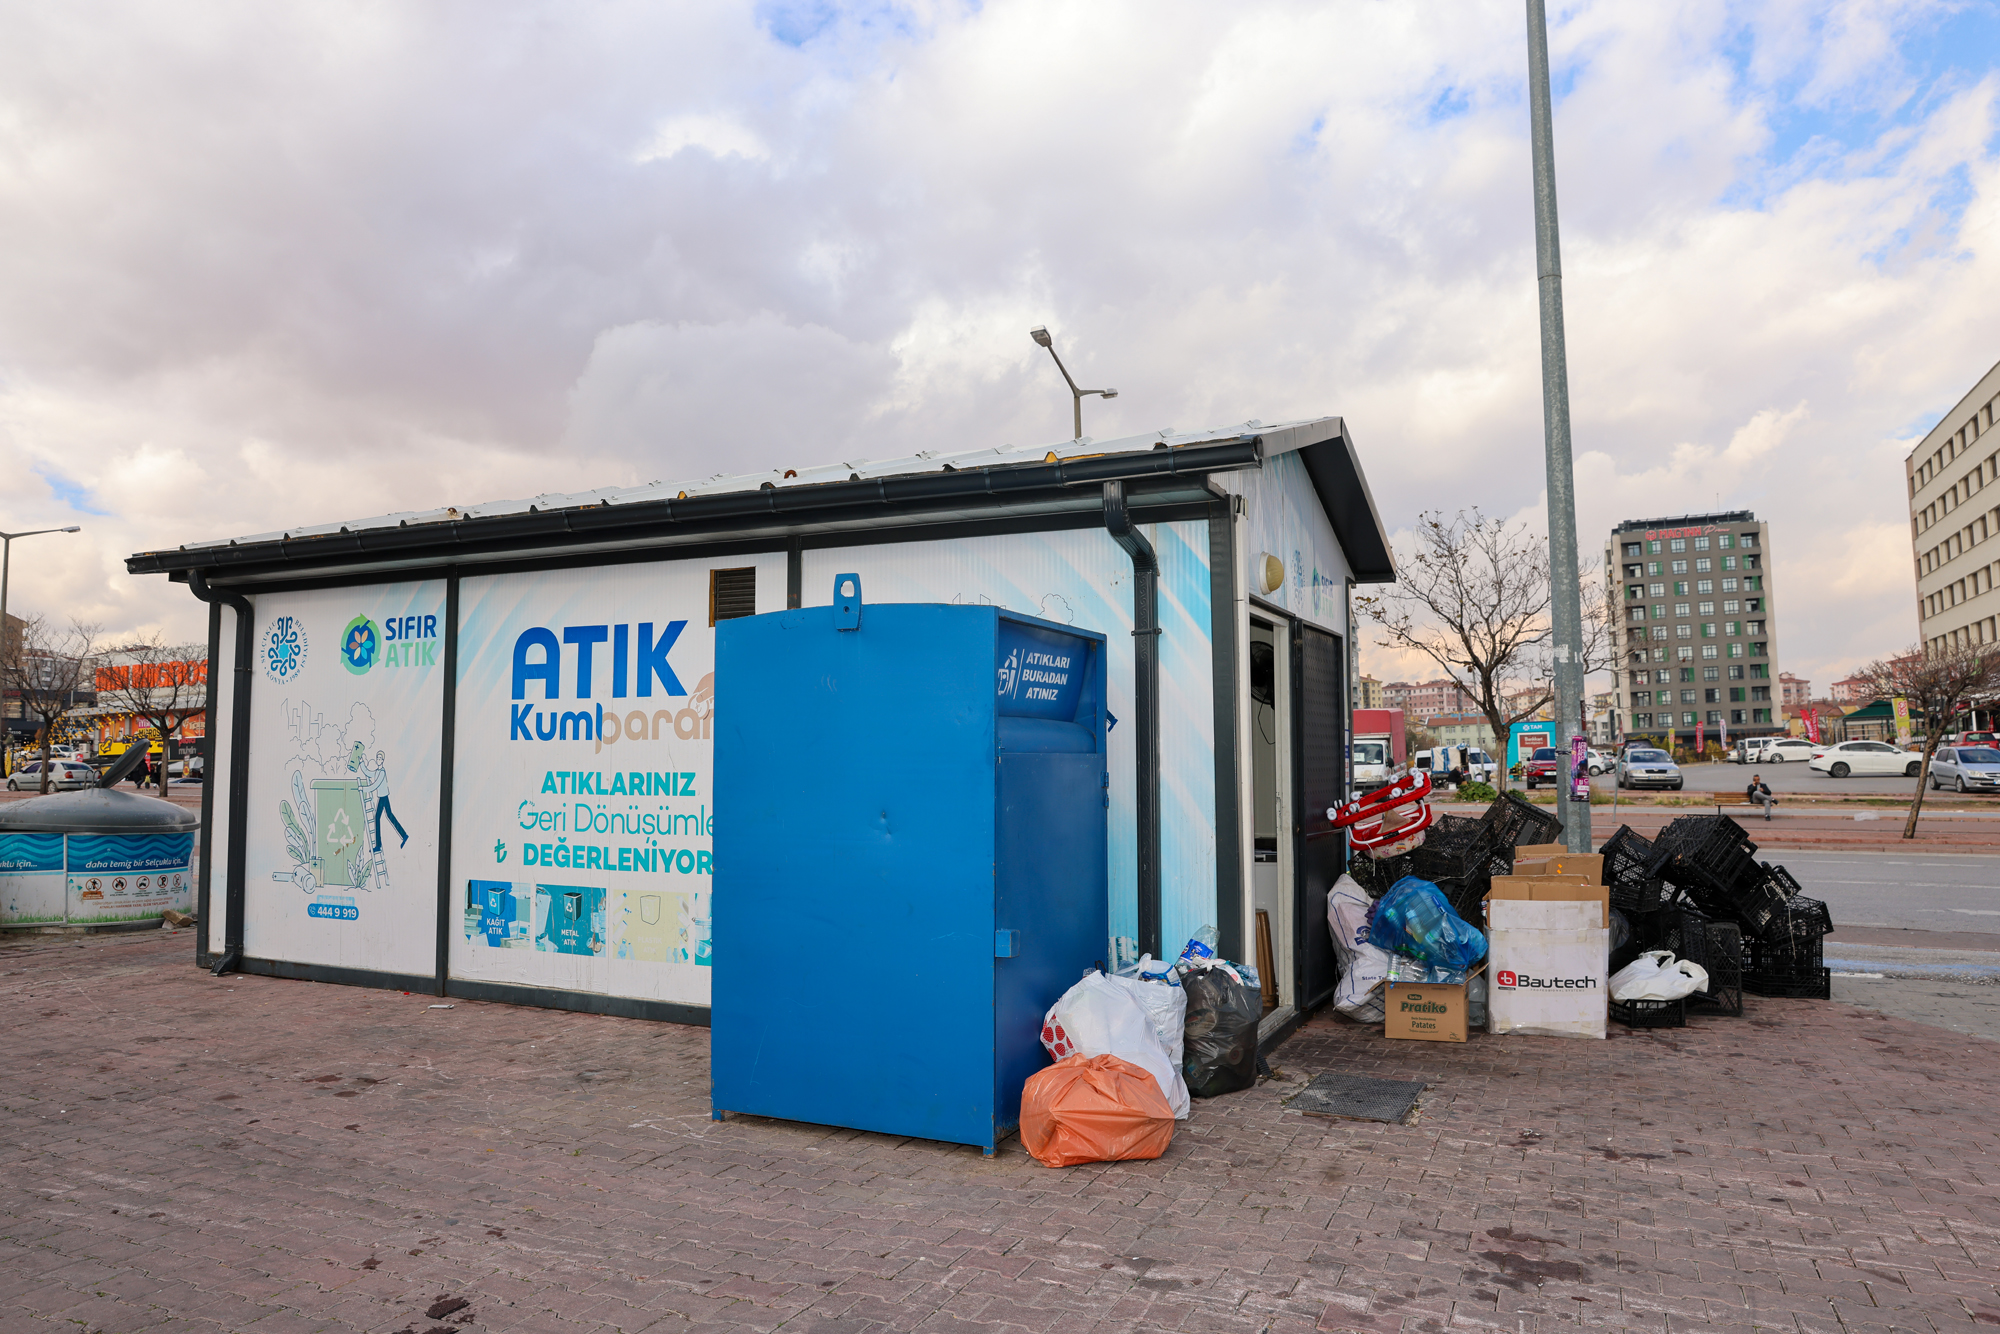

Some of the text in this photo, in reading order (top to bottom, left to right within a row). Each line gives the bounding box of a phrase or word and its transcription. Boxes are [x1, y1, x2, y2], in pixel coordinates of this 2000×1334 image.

[385, 614, 437, 641] SIFIR
[384, 640, 437, 668] ATIK
[511, 620, 689, 700] ATIK
[1026, 652, 1070, 669] ATIKLARI
[266, 669, 301, 685] KONYA 1989
[1022, 669, 1068, 685] BURADAN
[1025, 687, 1059, 700] ATINIZ
[541, 771, 696, 797] ATIKLARINIZ
[518, 799, 566, 830] Geri
[523, 836, 714, 875] DEĞERLENİYOR
[85, 860, 108, 869] daha
[110, 860, 132, 870] temiz
[133, 859, 144, 867] bir
[145, 858, 172, 868] Selçuklu
[317, 906, 357, 918] 444 9 919
[486, 917, 505, 928] KAĞIT
[488, 927, 503, 936] ATIK
[561, 929, 579, 938] METAL
[563, 939, 577, 947] ATIK
[1518, 975, 1597, 988] Bautech
[1400, 1001, 1447, 1014] Pratiko
[1411, 1021, 1436, 1029] Patates
